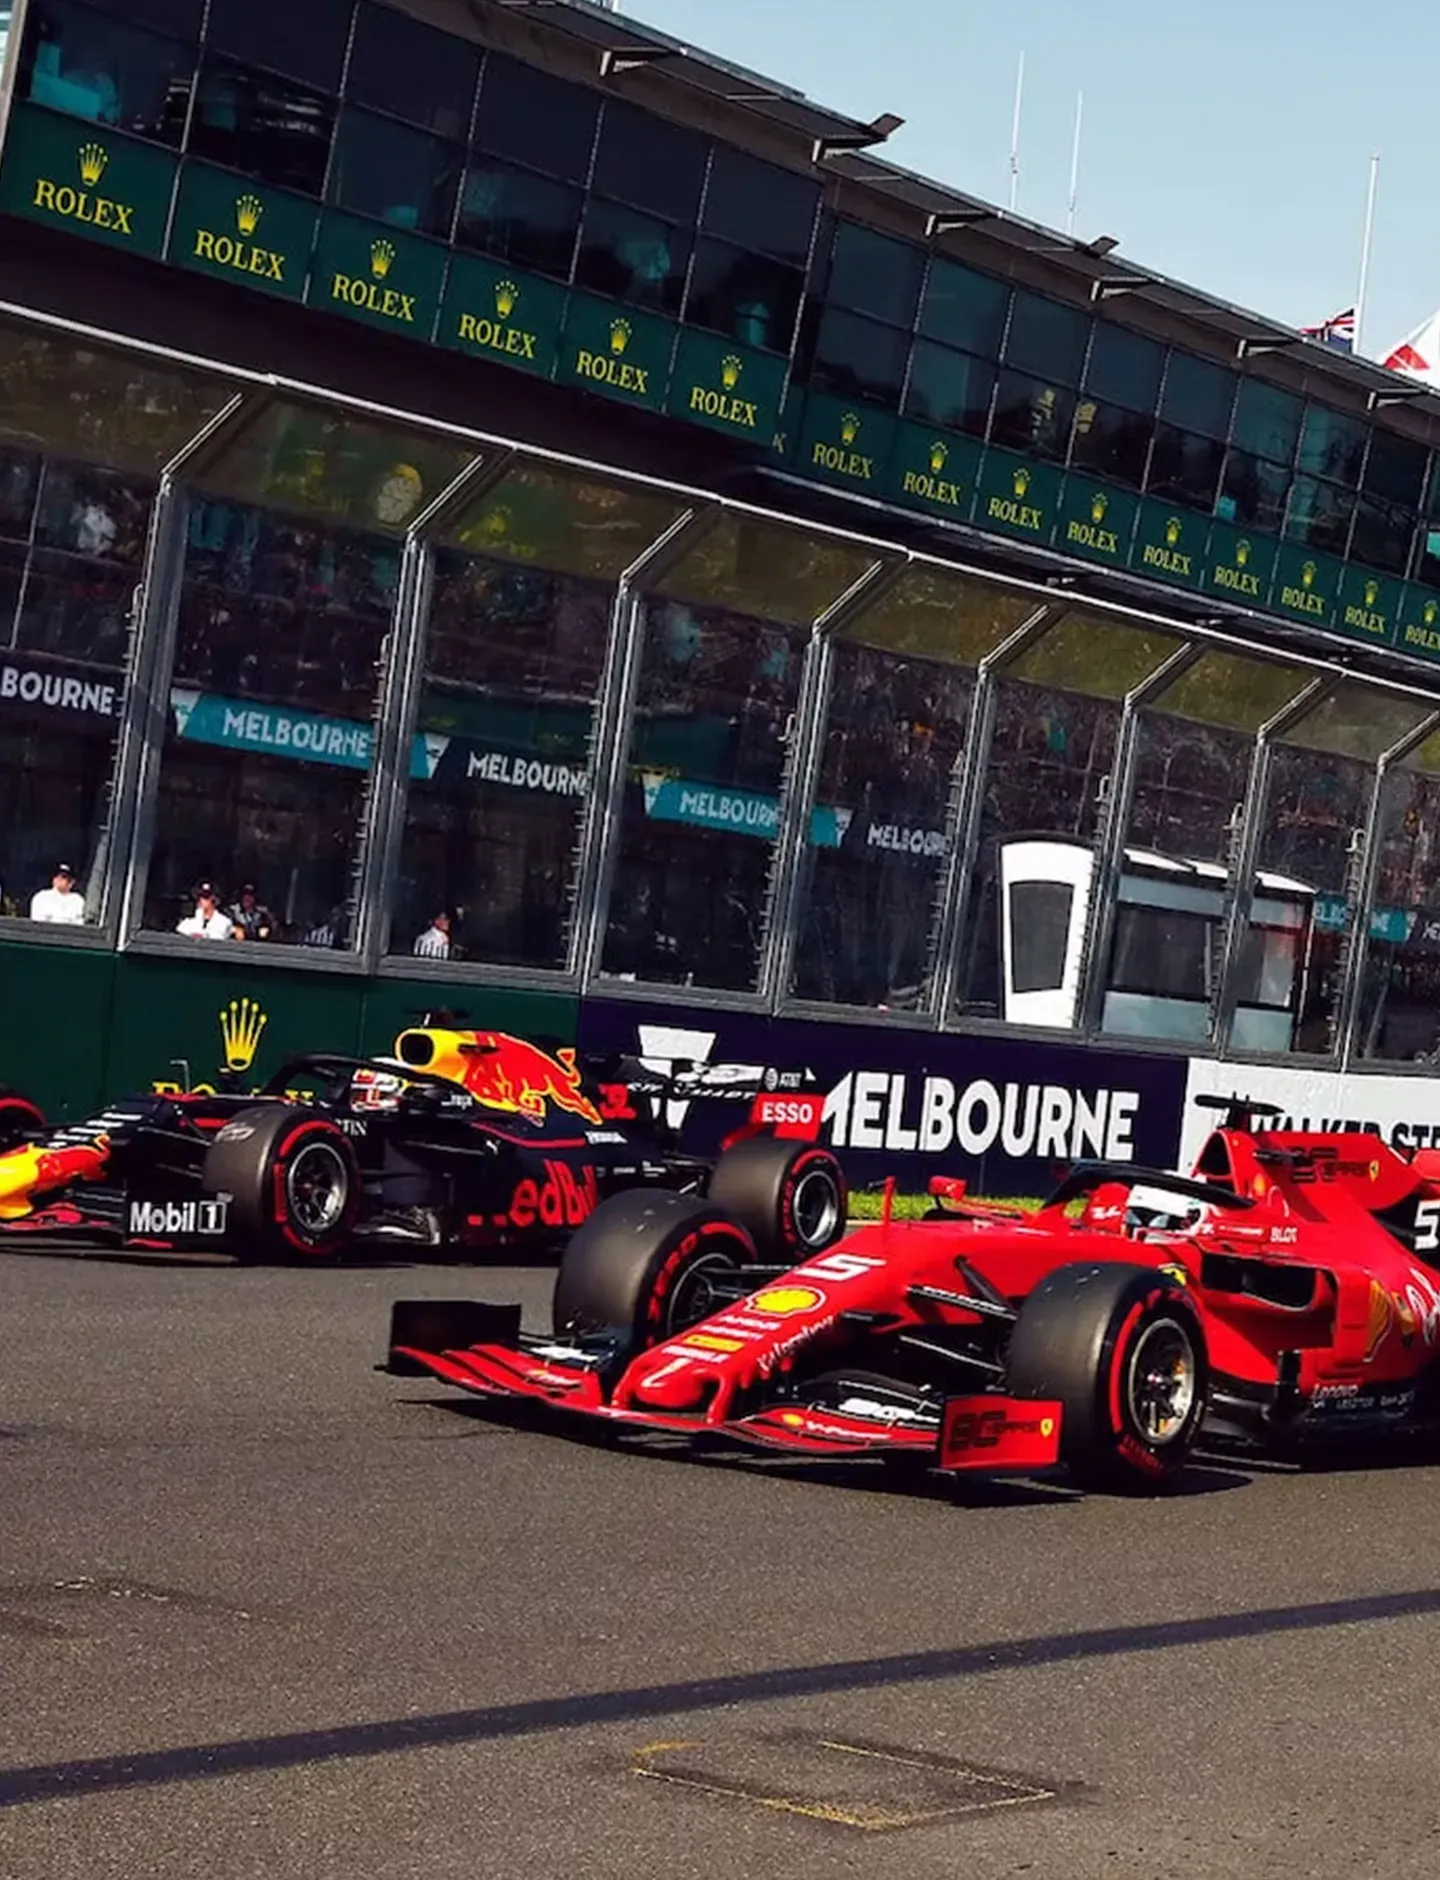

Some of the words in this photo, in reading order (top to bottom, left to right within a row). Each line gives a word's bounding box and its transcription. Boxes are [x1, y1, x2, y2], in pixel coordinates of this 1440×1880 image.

[34, 179, 135, 235] ROLEX
[194, 230, 285, 281] ROLEX
[331, 274, 416, 322] ROLEX
[457, 313, 537, 359] ROLEX
[575, 351, 649, 393] ROLEX
[690, 386, 757, 428] ROLEX
[812, 444, 874, 479] ROLEX
[903, 472, 961, 506] ROLEX
[987, 497, 1042, 530] ROLEX
[1067, 520, 1119, 553] ROLEX
[1143, 544, 1192, 576] ROLEX
[1213, 566, 1260, 596] ROLEX
[1281, 586, 1325, 616] ROLEX
[1344, 605, 1386, 635] ROLEX
[222, 708, 369, 758] MELBOURNE
[762, 1102, 813, 1124] ESSO
[129, 1201, 196, 1232] Mobil
[795, 1253, 888, 1282] 5
